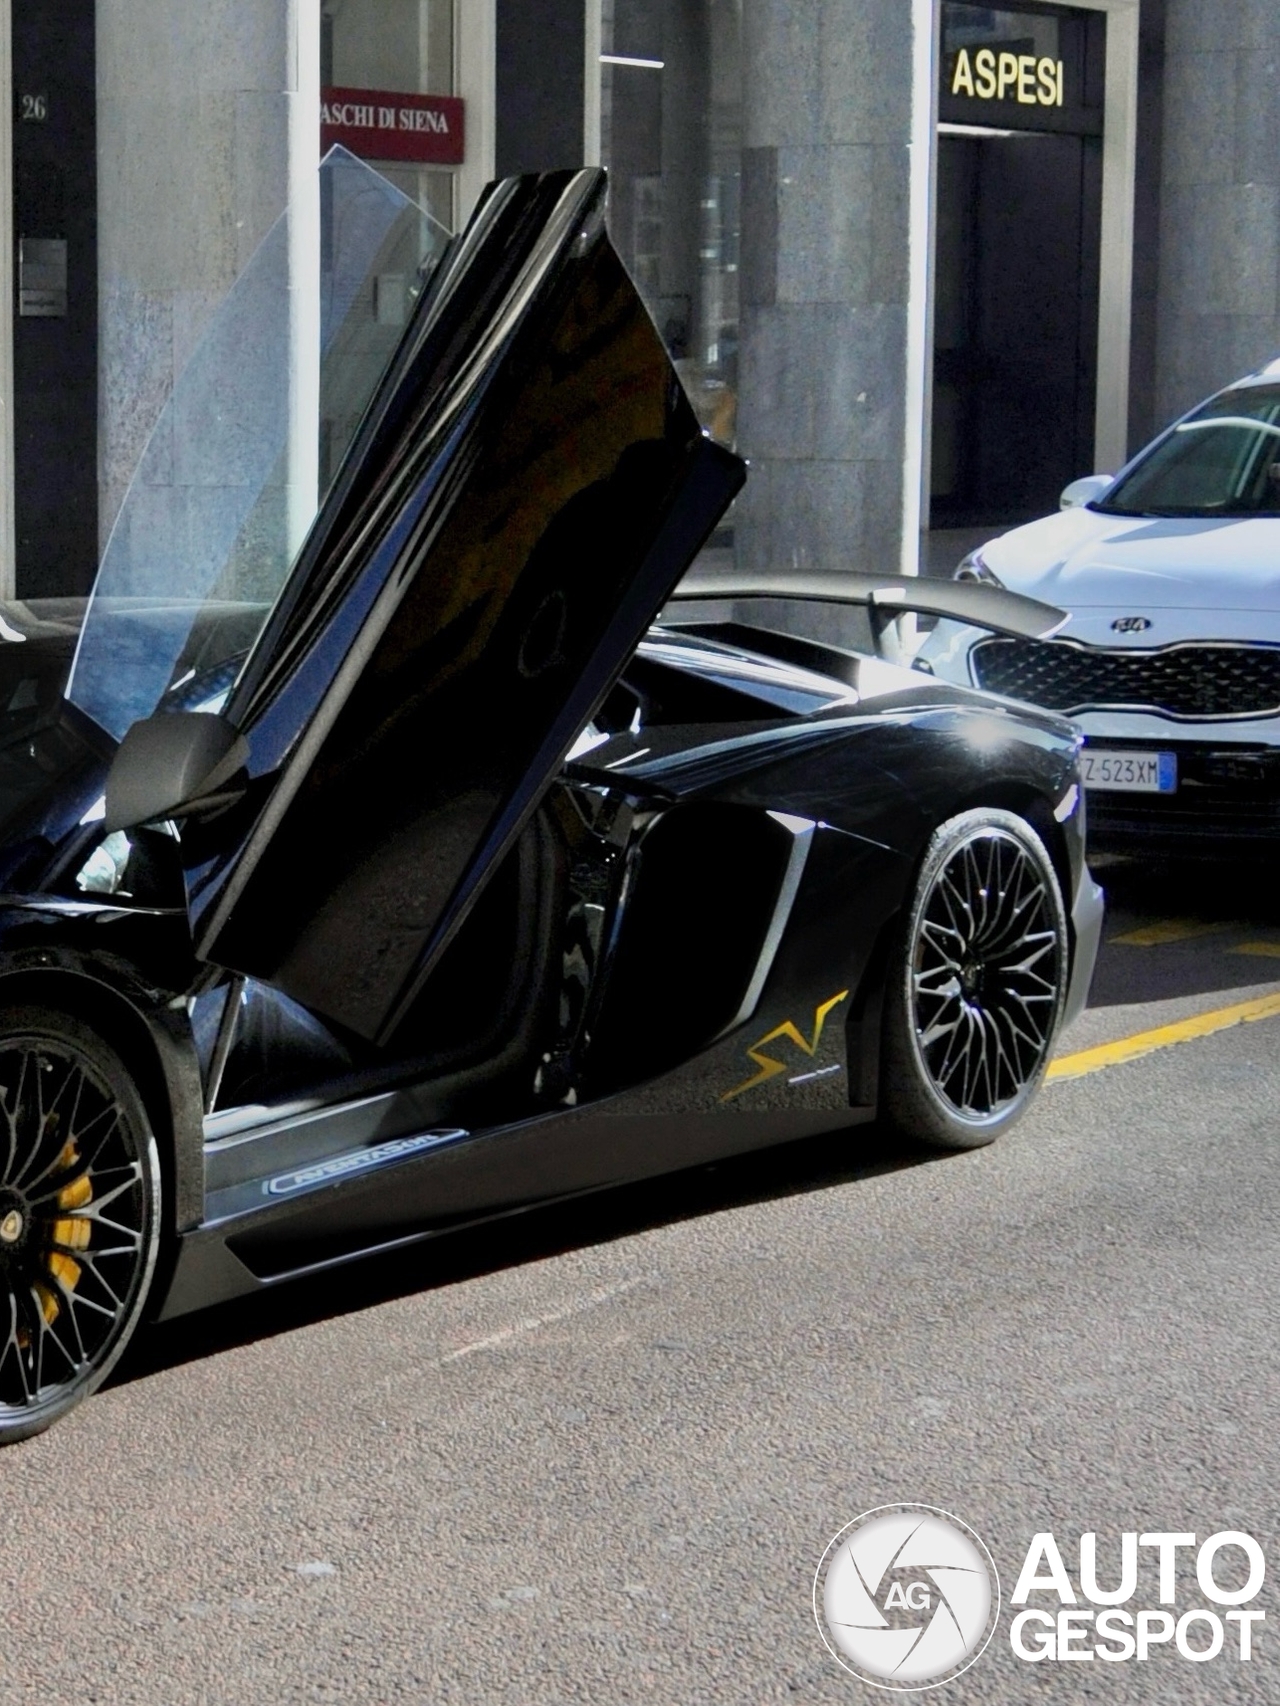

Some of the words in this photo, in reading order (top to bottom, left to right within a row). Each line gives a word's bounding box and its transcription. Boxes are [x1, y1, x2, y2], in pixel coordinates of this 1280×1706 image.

[951, 48, 1063, 107] ASPESI
[22, 94, 46, 120] 26
[320, 102, 375, 128] ASCHI
[378, 106, 397, 130] DI
[399, 108, 449, 134] SIENA
